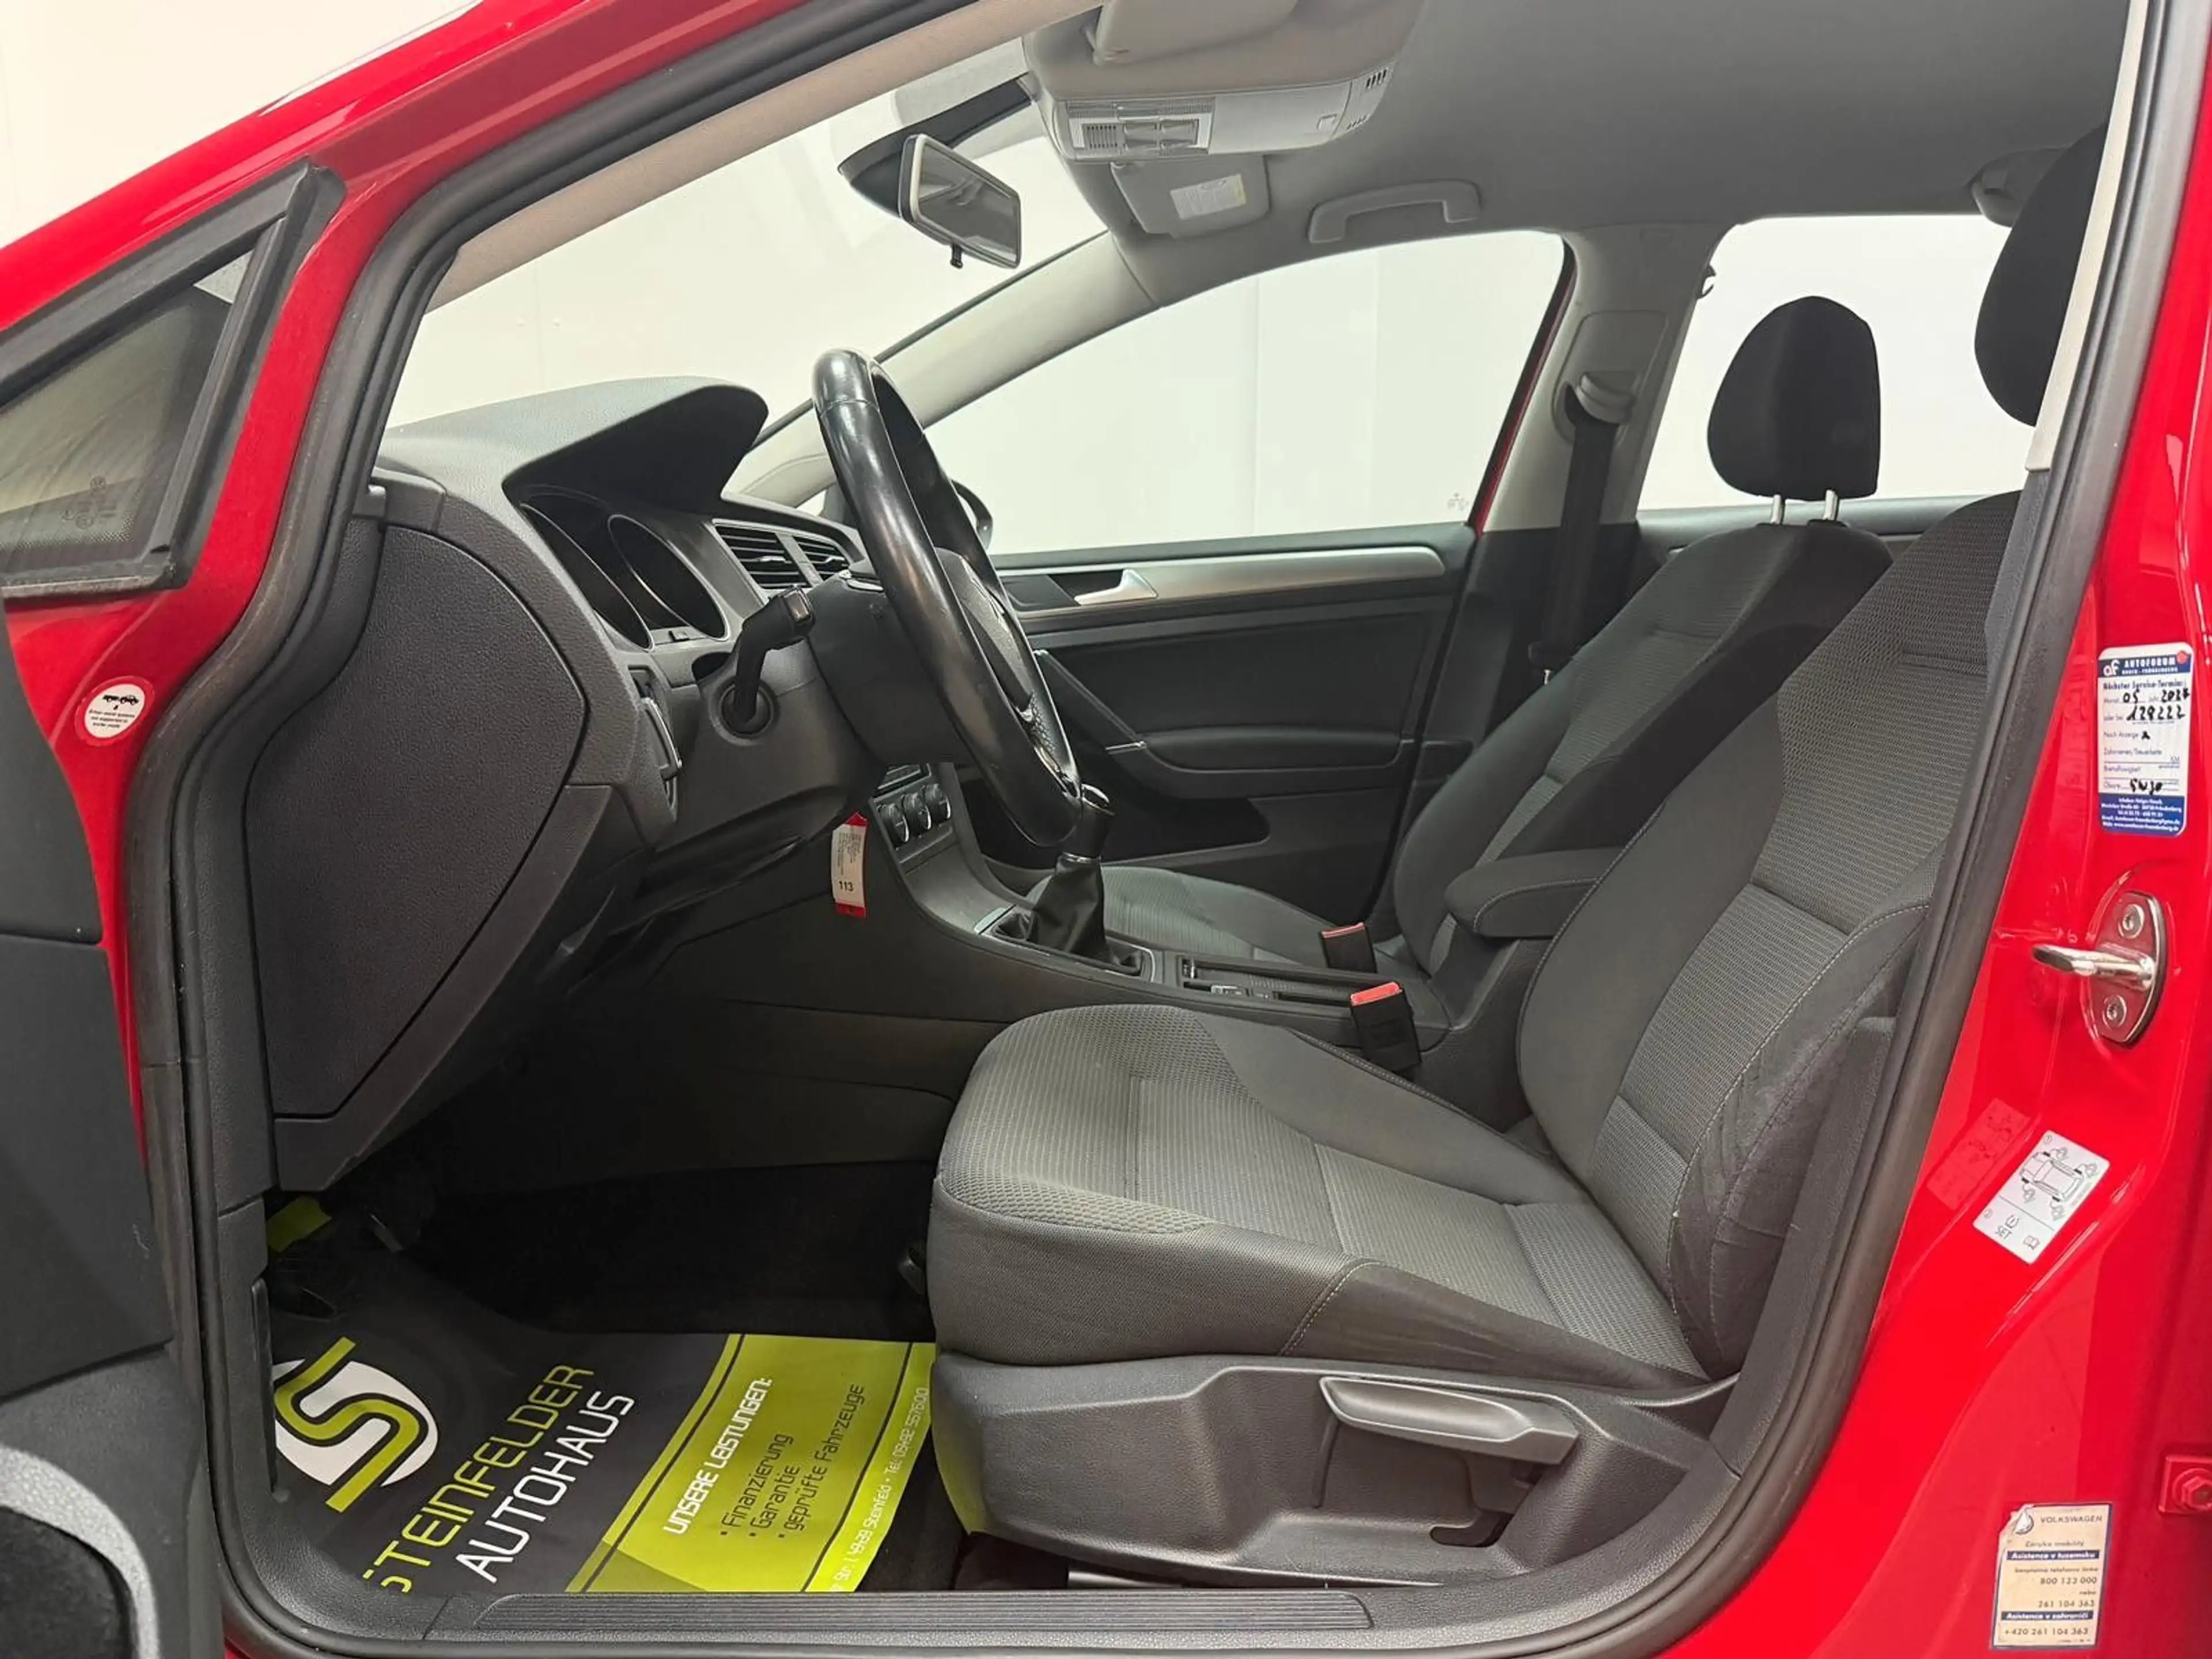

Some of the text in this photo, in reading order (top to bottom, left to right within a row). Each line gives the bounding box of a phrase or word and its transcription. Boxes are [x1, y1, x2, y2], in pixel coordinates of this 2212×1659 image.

[2124, 657, 2176, 668] AUTOFORUM
[2123, 690, 2139, 704] 05
[839, 881, 854, 892] 113
[784, 1383, 865, 1532] geprüfte Fahrzeuge
[455, 1390, 635, 1584] AUTOHAUS
[721, 1433, 794, 1528] Finanzierung
[749, 1465, 800, 1530] Garantie
[662, 1470, 718, 1536] UNSERE
[2040, 1515, 2103, 1524] VOLKSWAGEN
[2011, 1551, 2049, 1559] Asistence
